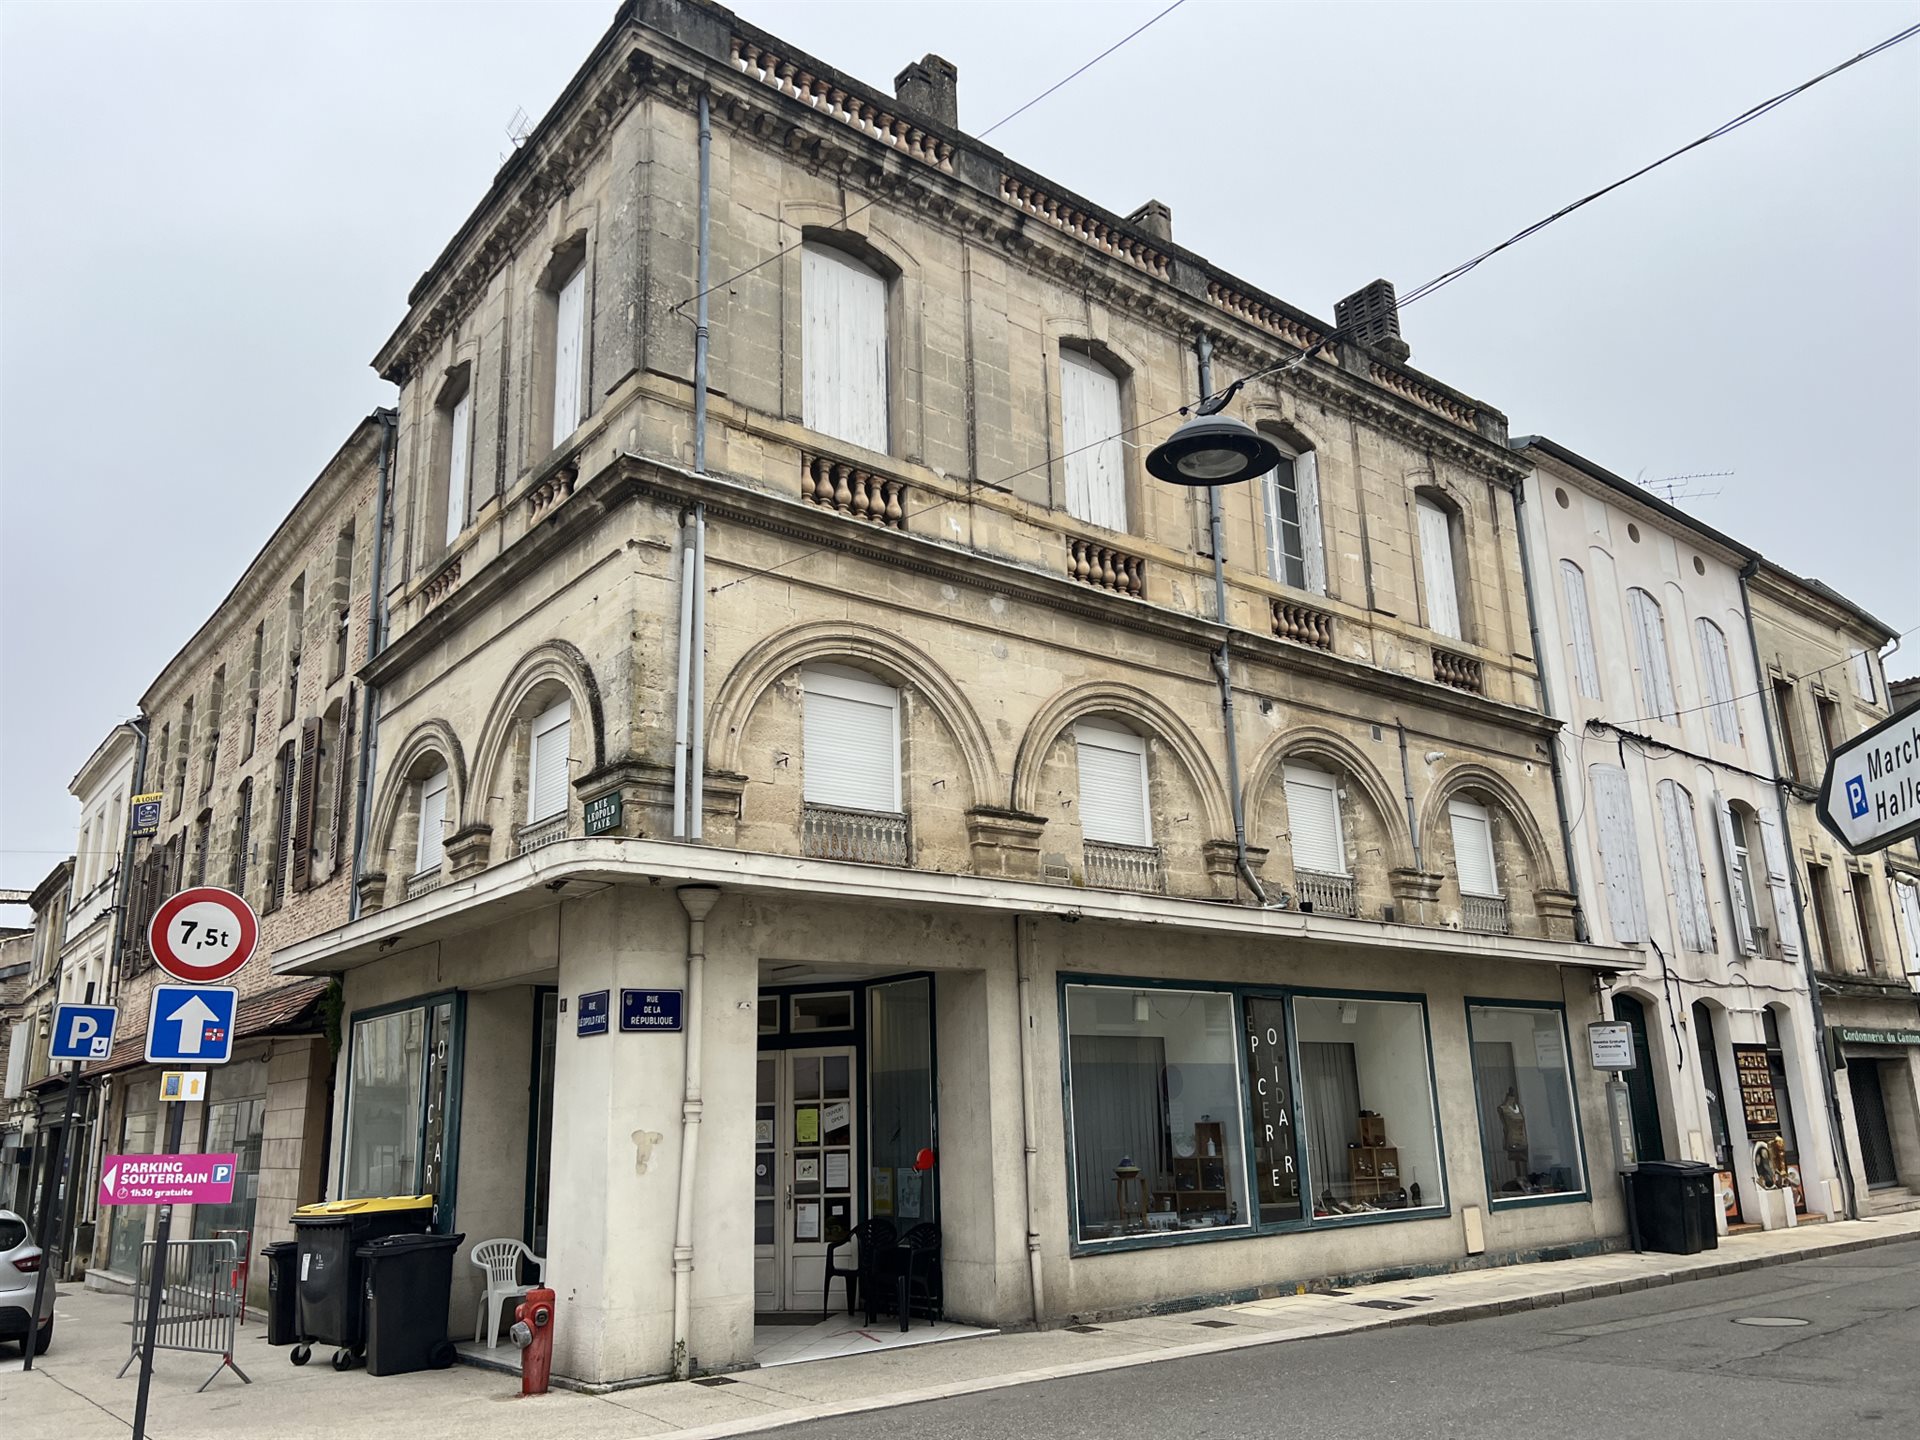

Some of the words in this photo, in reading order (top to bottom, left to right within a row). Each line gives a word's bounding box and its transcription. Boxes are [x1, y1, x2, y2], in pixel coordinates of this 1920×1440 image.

[594, 798, 608, 811] RUE
[593, 816, 611, 831] FAYE
[646, 995, 659, 1003] RUE
[588, 1002, 596, 1010] RUE
[595, 1015, 606, 1025] FAYE
[630, 1014, 673, 1025] RÉPUBLIQUE
[68, 1015, 98, 1049] P
[1842, 1029, 1885, 1042] Cordonnerie
[1886, 1032, 1896, 1043] du
[831, 1114, 844, 1123] OPEN
[122, 1162, 183, 1174] PARKING
[120, 1173, 208, 1185] SOUTERRAIN
[131, 1188, 153, 1197] 1h30
[154, 1187, 193, 1198] gratuite
